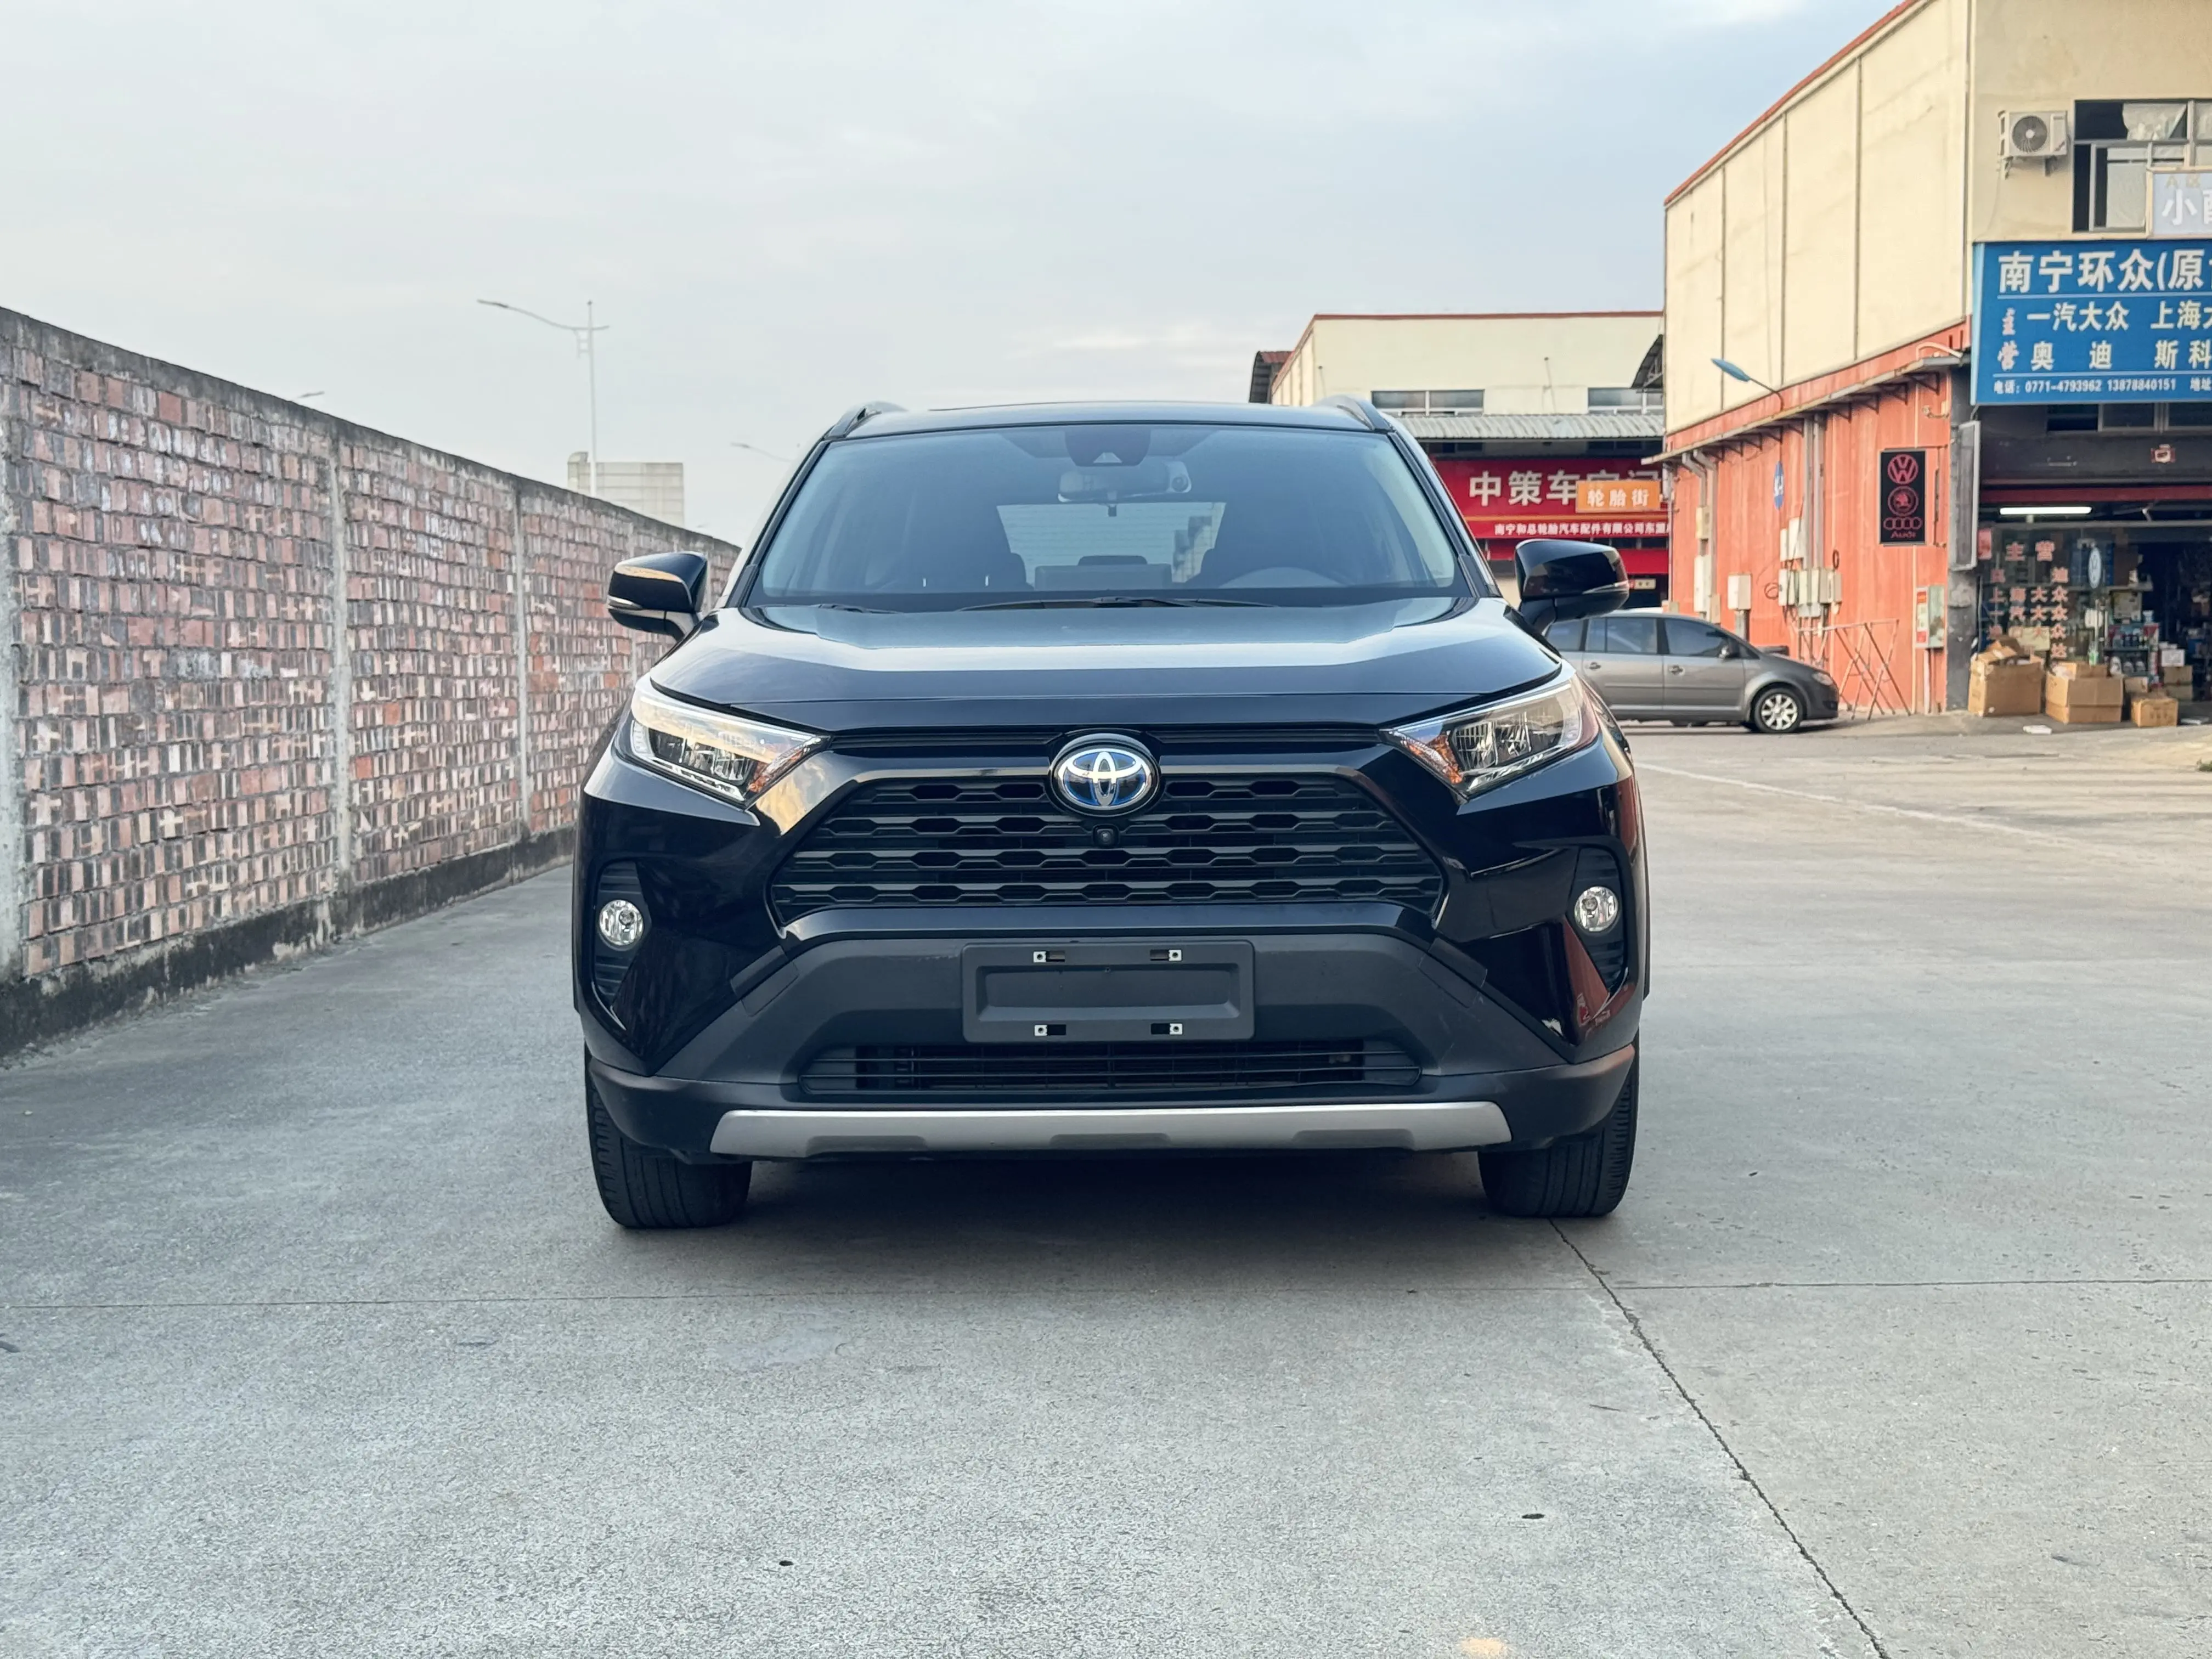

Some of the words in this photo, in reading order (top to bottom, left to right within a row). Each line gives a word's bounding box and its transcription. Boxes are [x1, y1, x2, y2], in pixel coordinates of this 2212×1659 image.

[1998, 248, 2212, 294] 南宁环众(原
[2027, 300, 2129, 331] 一汽大众
[1587, 488, 1649, 507] 轮胎街
